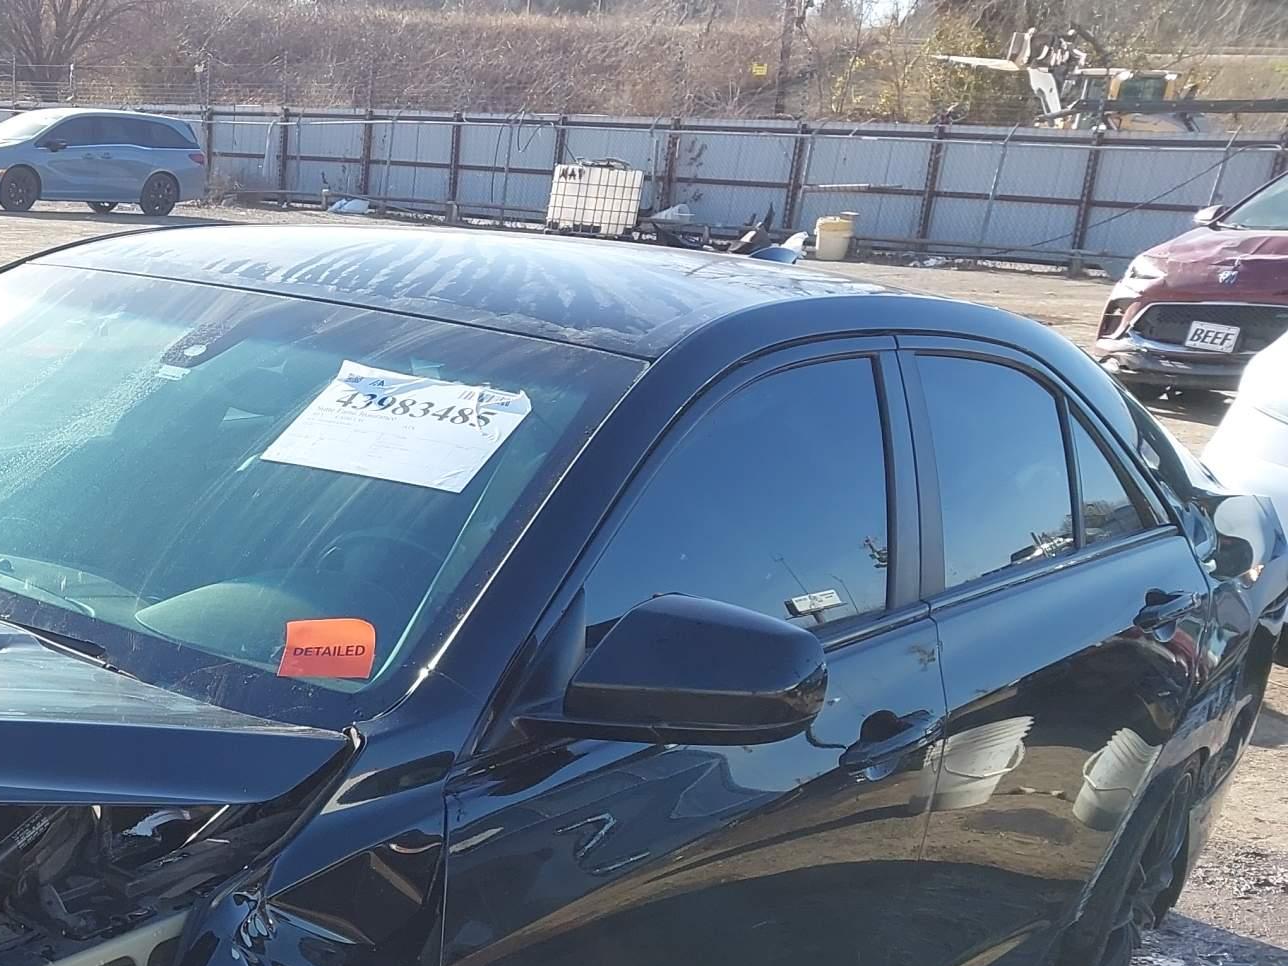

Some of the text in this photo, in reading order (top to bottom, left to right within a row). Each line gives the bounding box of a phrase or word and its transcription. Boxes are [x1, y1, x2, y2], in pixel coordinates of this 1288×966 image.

[1190, 328, 1235, 346] BEEF
[336, 391, 497, 427] 43983485
[293, 645, 366, 657] DETAILED
